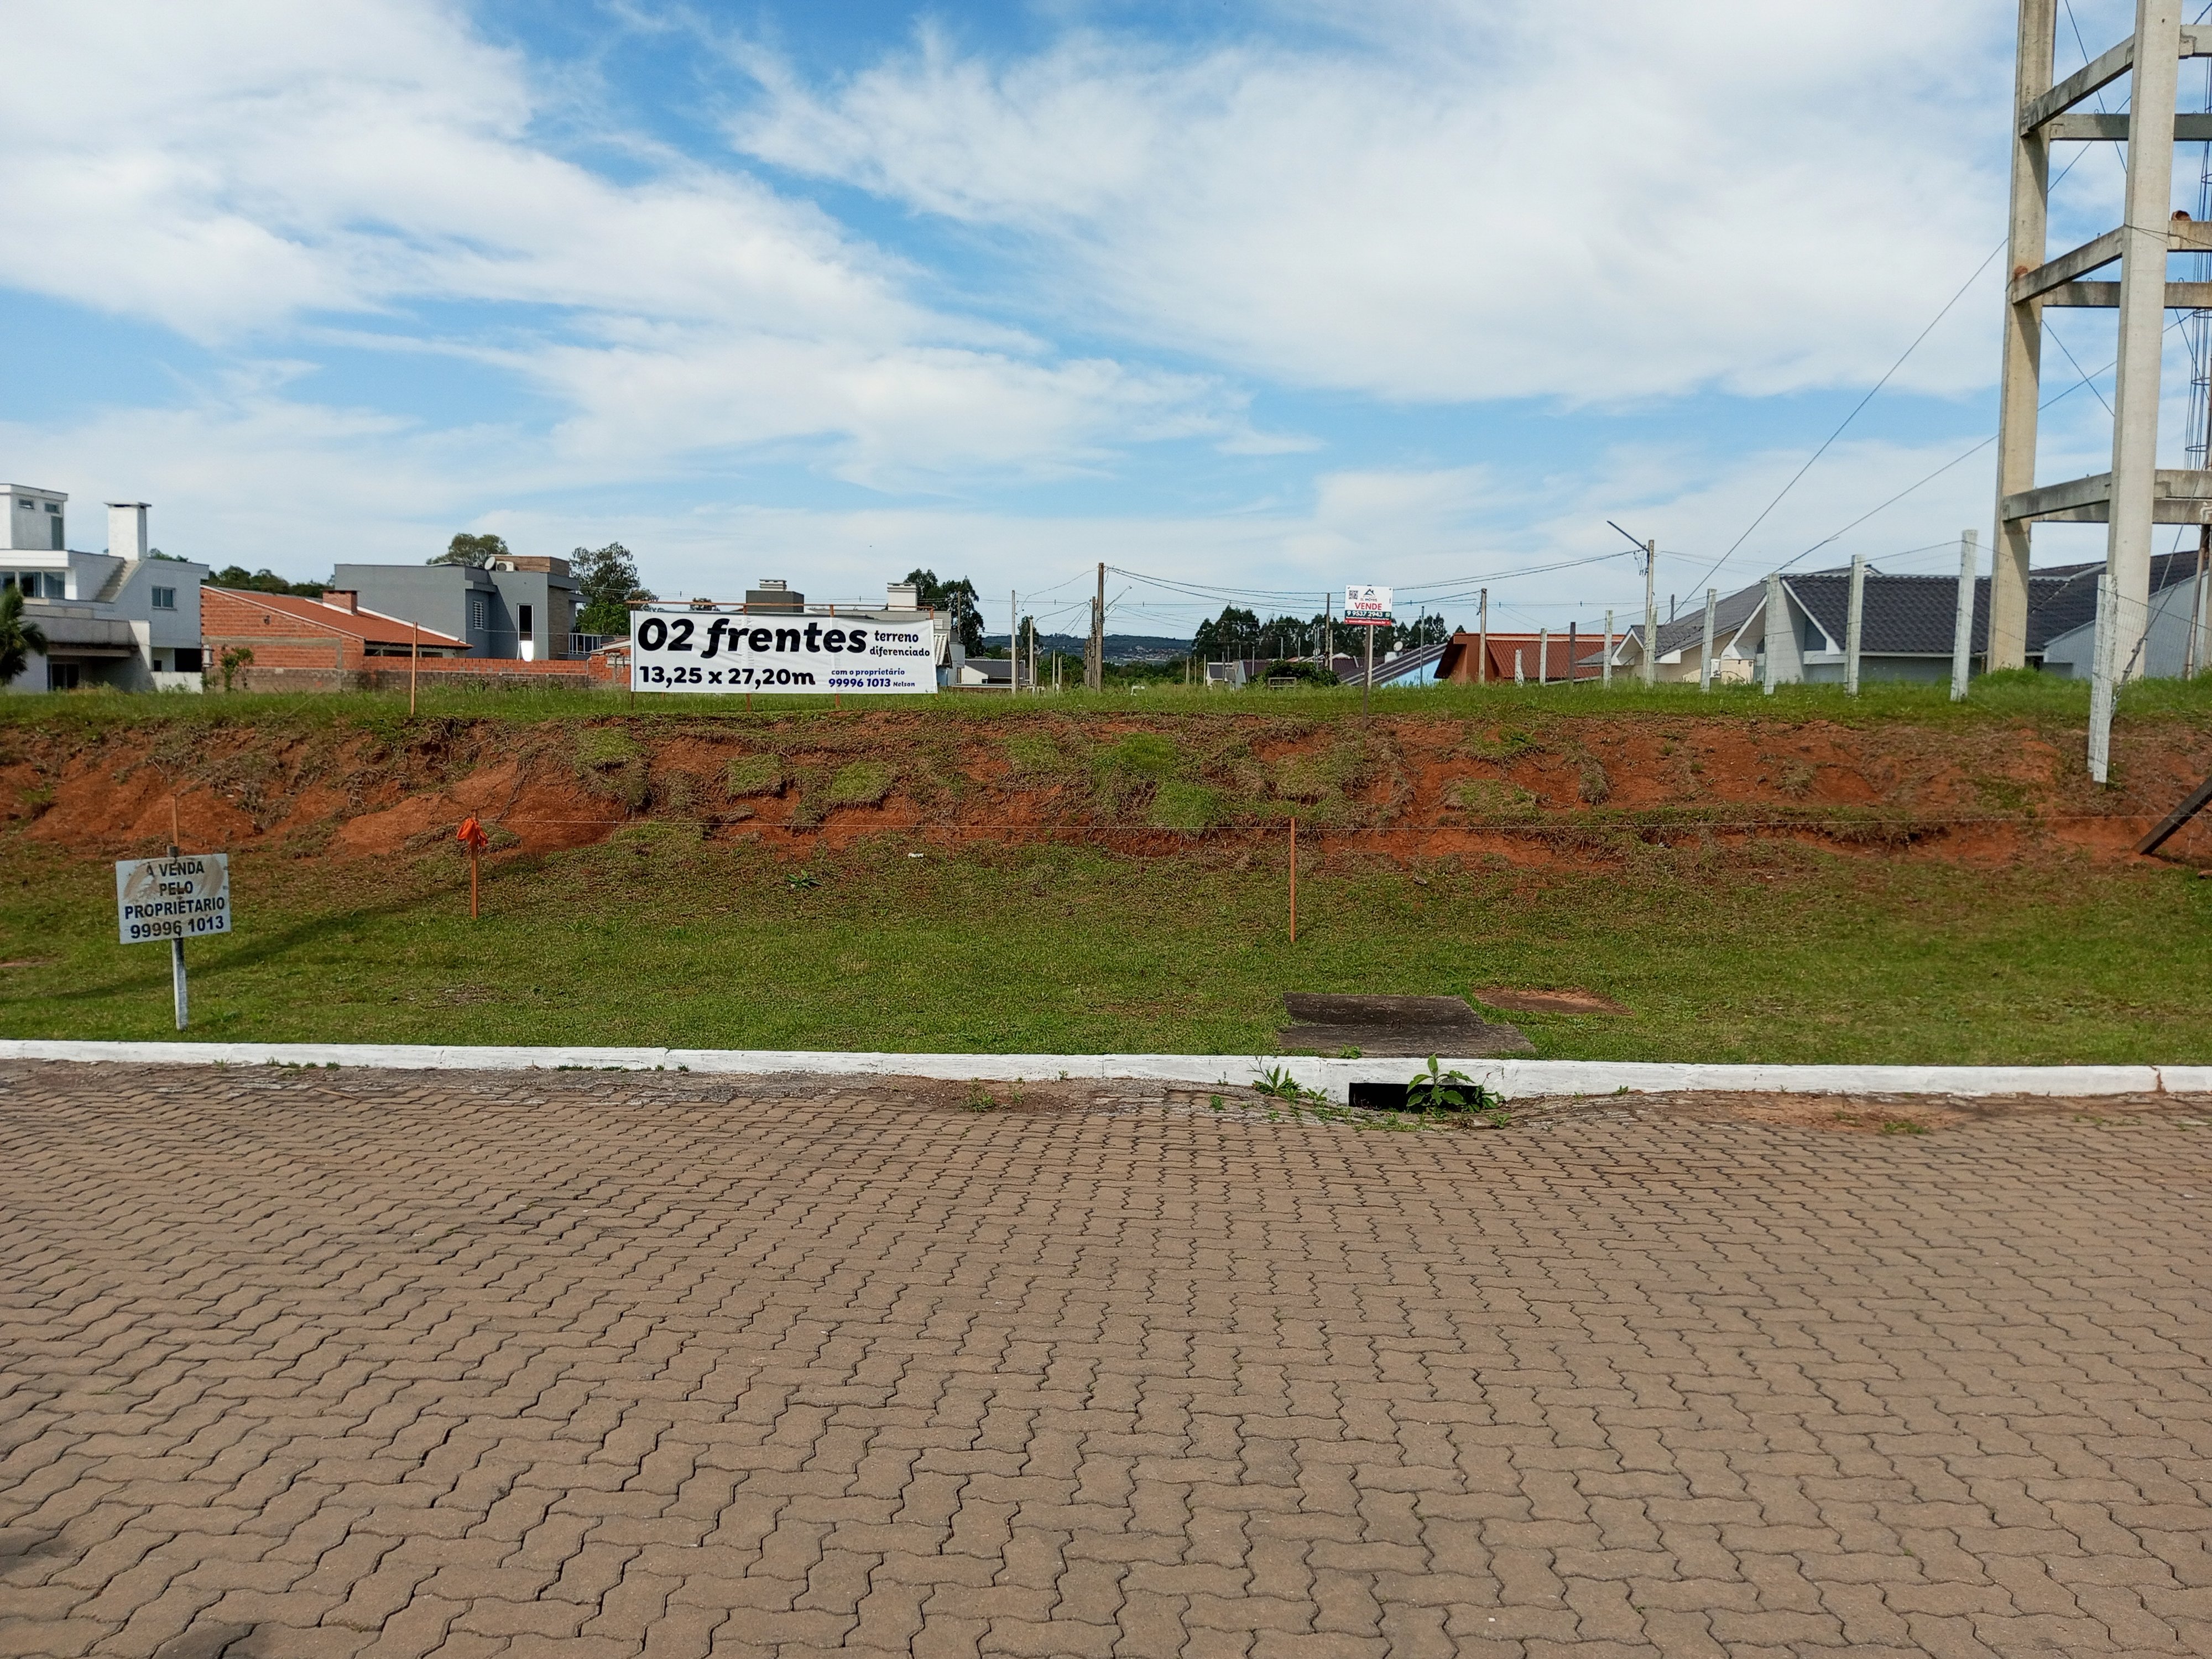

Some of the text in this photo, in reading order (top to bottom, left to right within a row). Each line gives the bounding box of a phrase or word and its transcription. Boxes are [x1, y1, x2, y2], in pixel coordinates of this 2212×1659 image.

[638, 618, 868, 659] 02 frentes
[874, 630, 919, 643] terreno
[870, 645, 930, 657] diferenciado
[639, 666, 816, 690] 13,25 x 27,20m
[855, 668, 905, 676] proprietário
[829, 678, 864, 687] 99996
[867, 678, 891, 687] 1013
[159, 861, 205, 877] VENDA
[159, 881, 193, 896] PELO
[124, 896, 225, 920] PROPRIETARIO
[130, 915, 224, 939] 99996 1013
